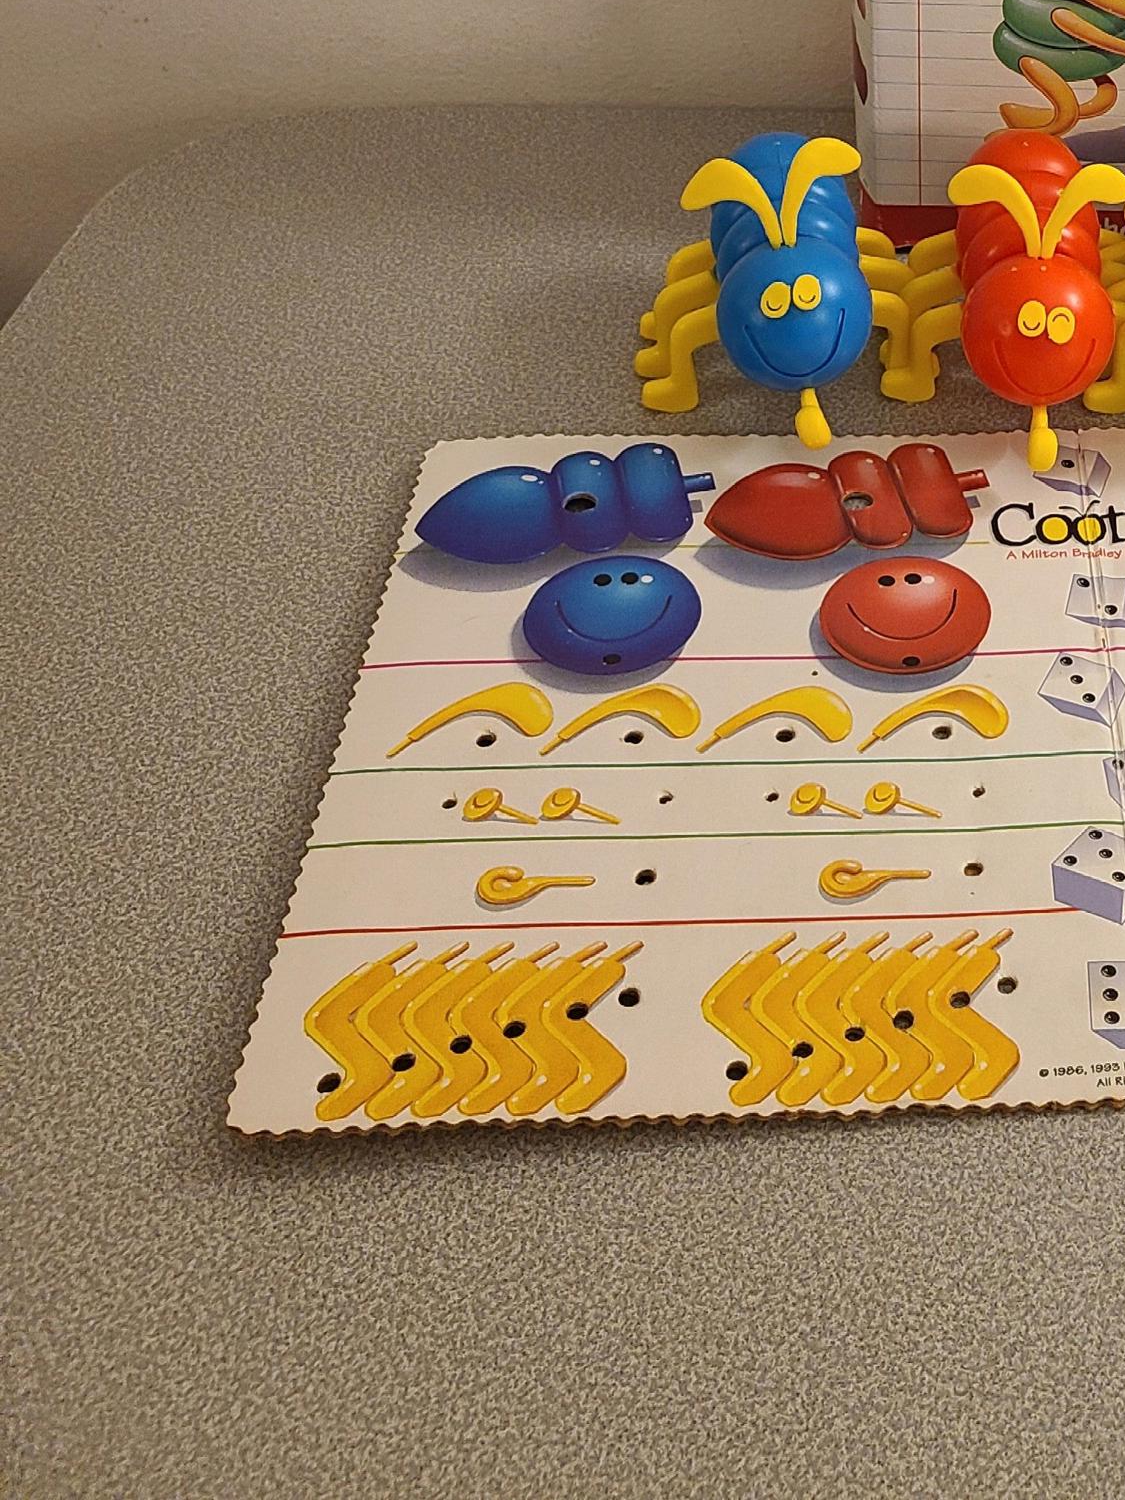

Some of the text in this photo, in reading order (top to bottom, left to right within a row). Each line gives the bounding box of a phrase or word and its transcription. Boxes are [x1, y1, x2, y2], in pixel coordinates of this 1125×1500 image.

[1006, 550, 1018, 560] A
[1021, 549, 1067, 559] Milton
[1072, 548, 1122, 559] Bradley
[1053, 1065, 1088, 1077] 1986,
[1090, 1062, 1121, 1073] 1993
[1097, 1077, 1112, 1087] All
